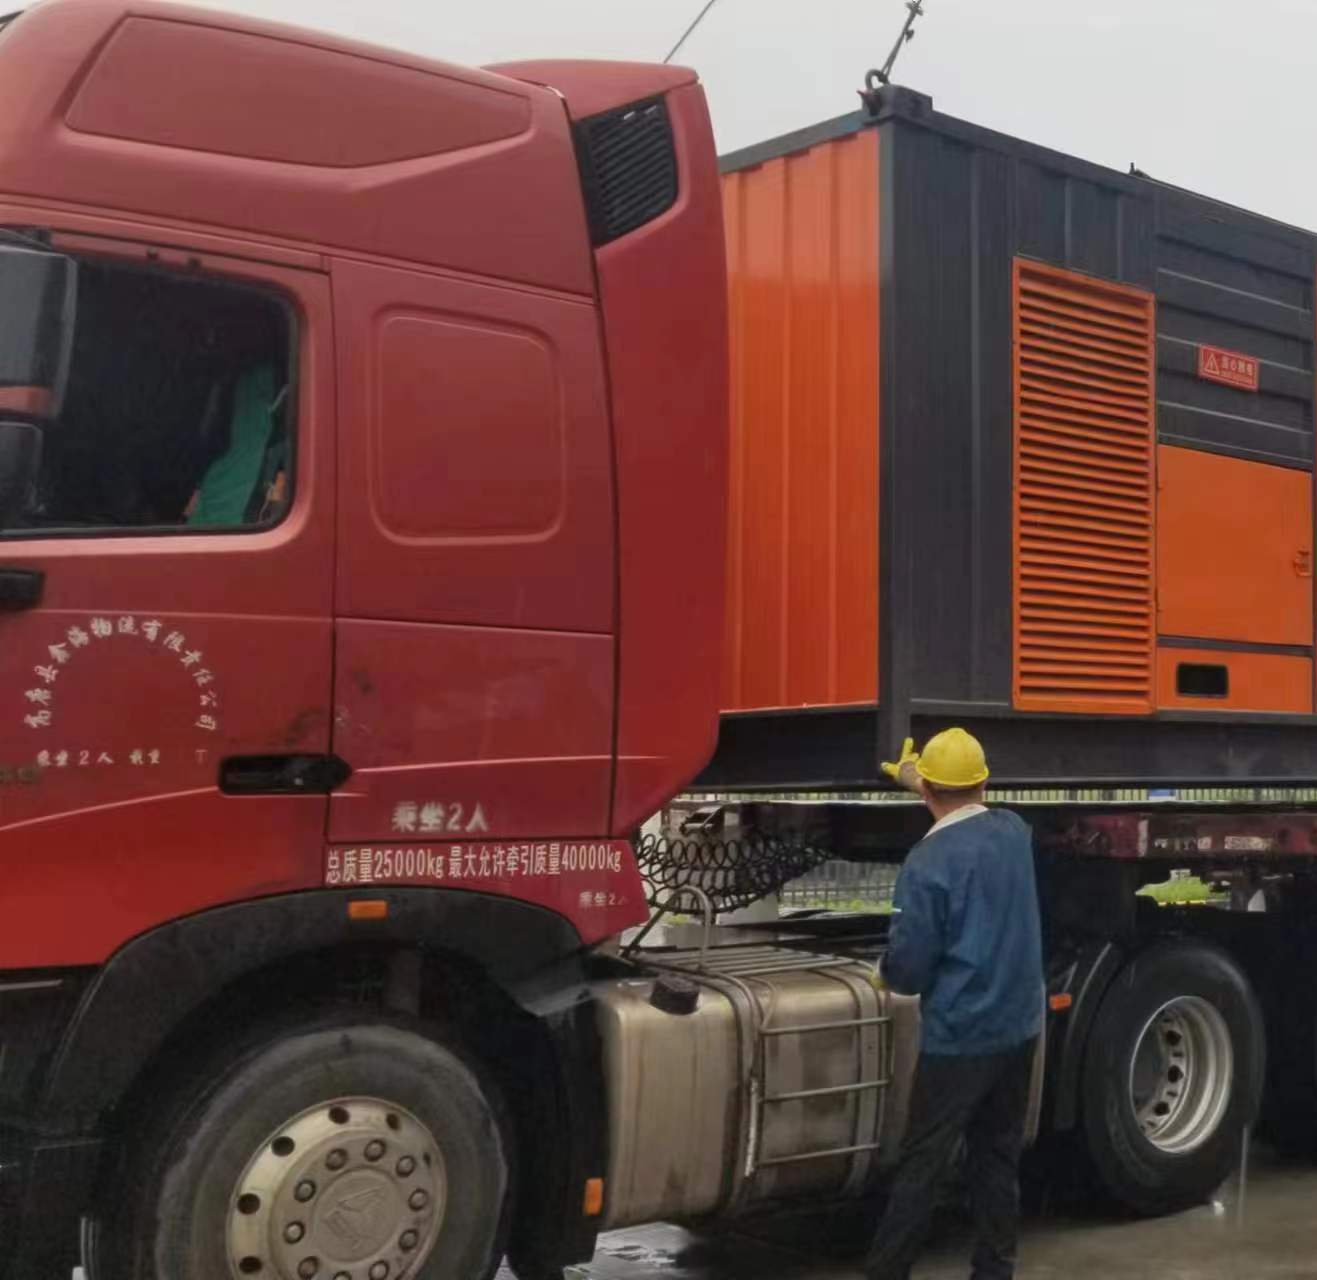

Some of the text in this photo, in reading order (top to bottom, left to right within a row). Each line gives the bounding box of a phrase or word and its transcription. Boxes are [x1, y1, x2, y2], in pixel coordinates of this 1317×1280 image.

[391, 802, 488, 833] 乘坐2人
[326, 843, 621, 883] 总质量25000kg 最大允许牵引质量40000kg
